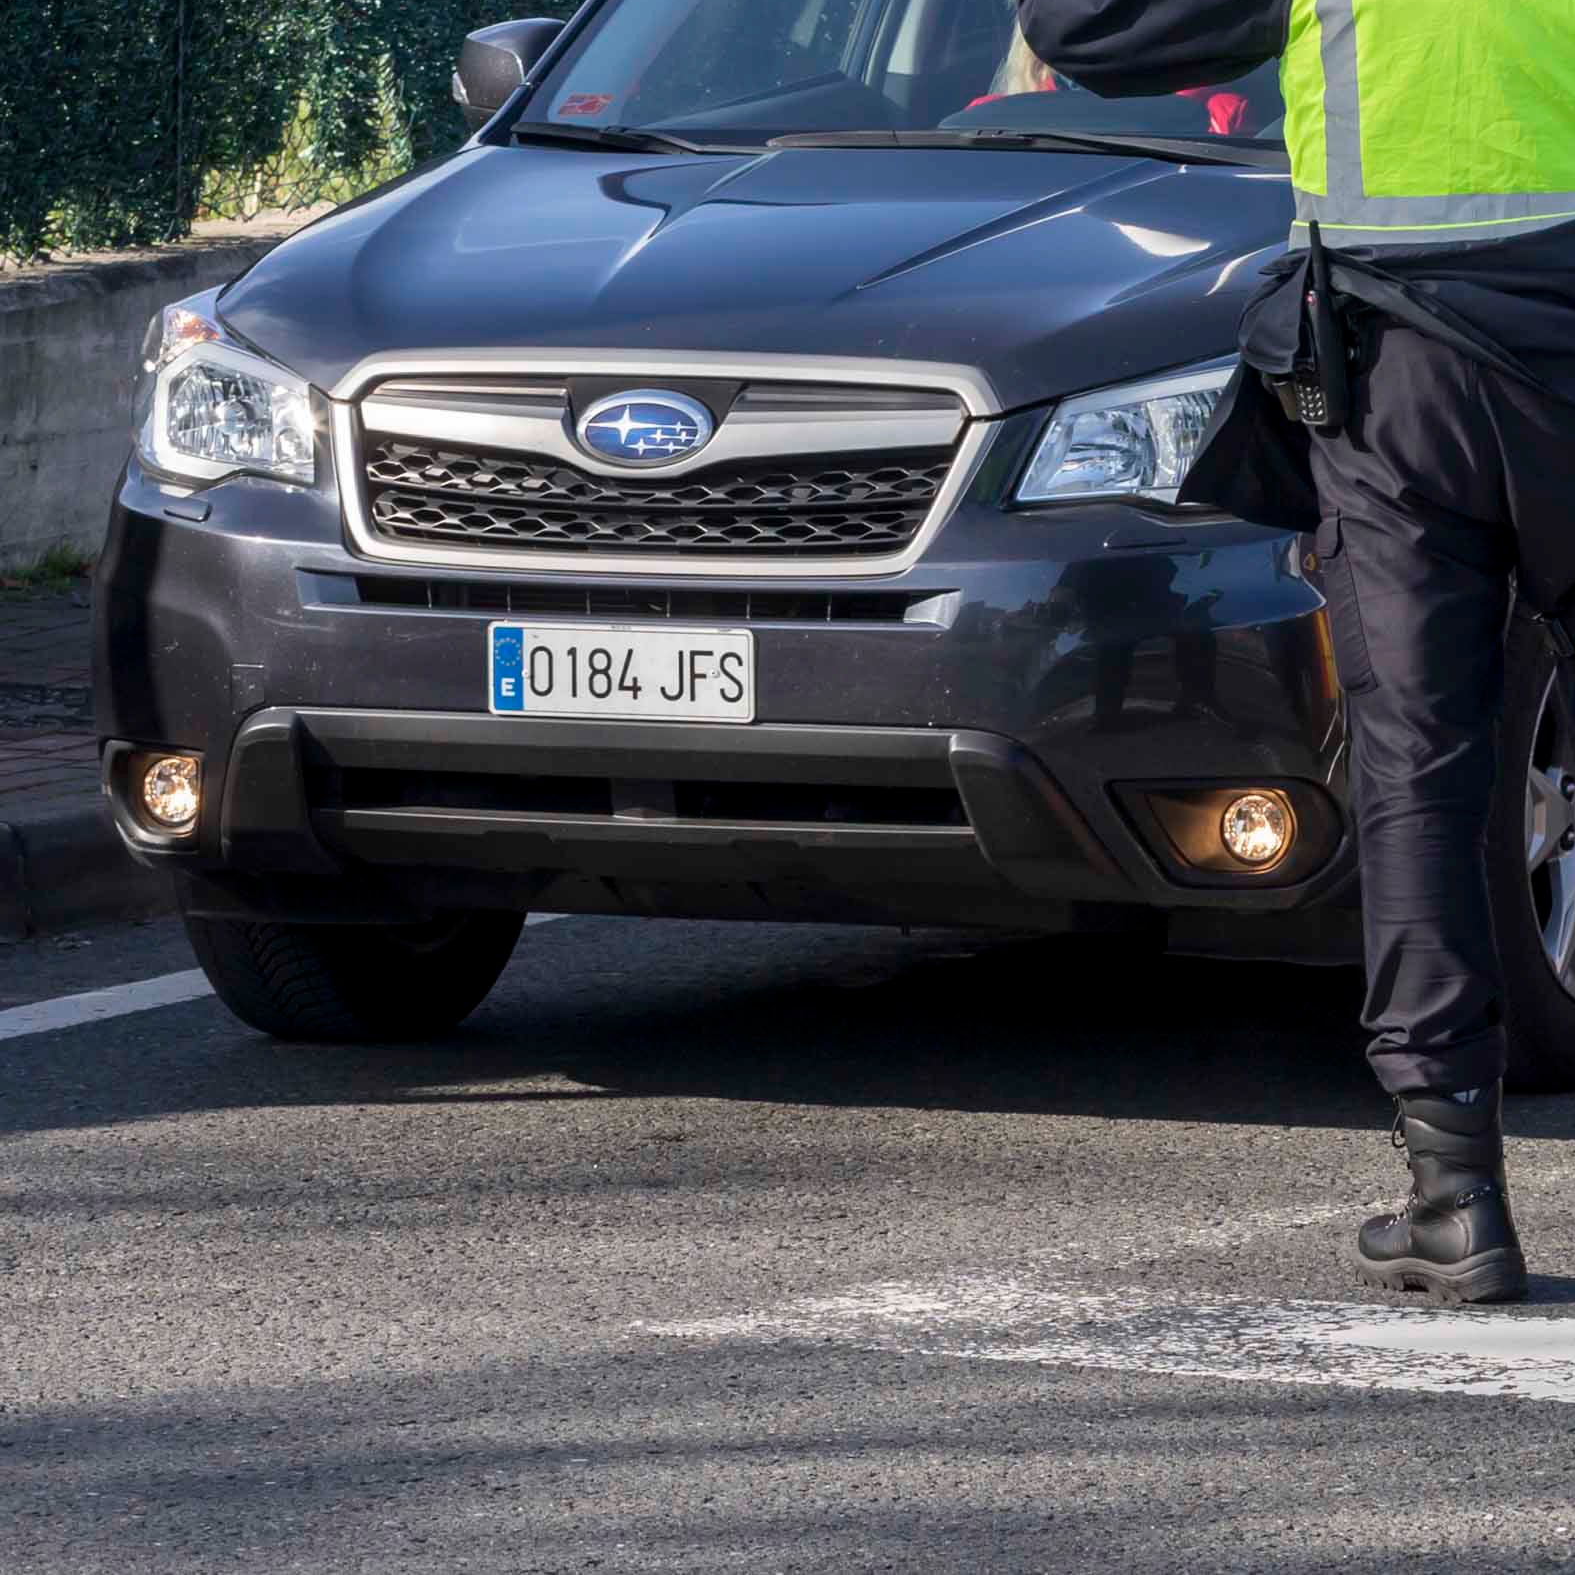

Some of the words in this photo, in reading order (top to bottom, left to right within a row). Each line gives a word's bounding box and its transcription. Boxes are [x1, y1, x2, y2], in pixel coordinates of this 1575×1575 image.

[500, 677, 516, 697] E
[529, 645, 643, 700] 0184
[659, 649, 744, 704] JFS
